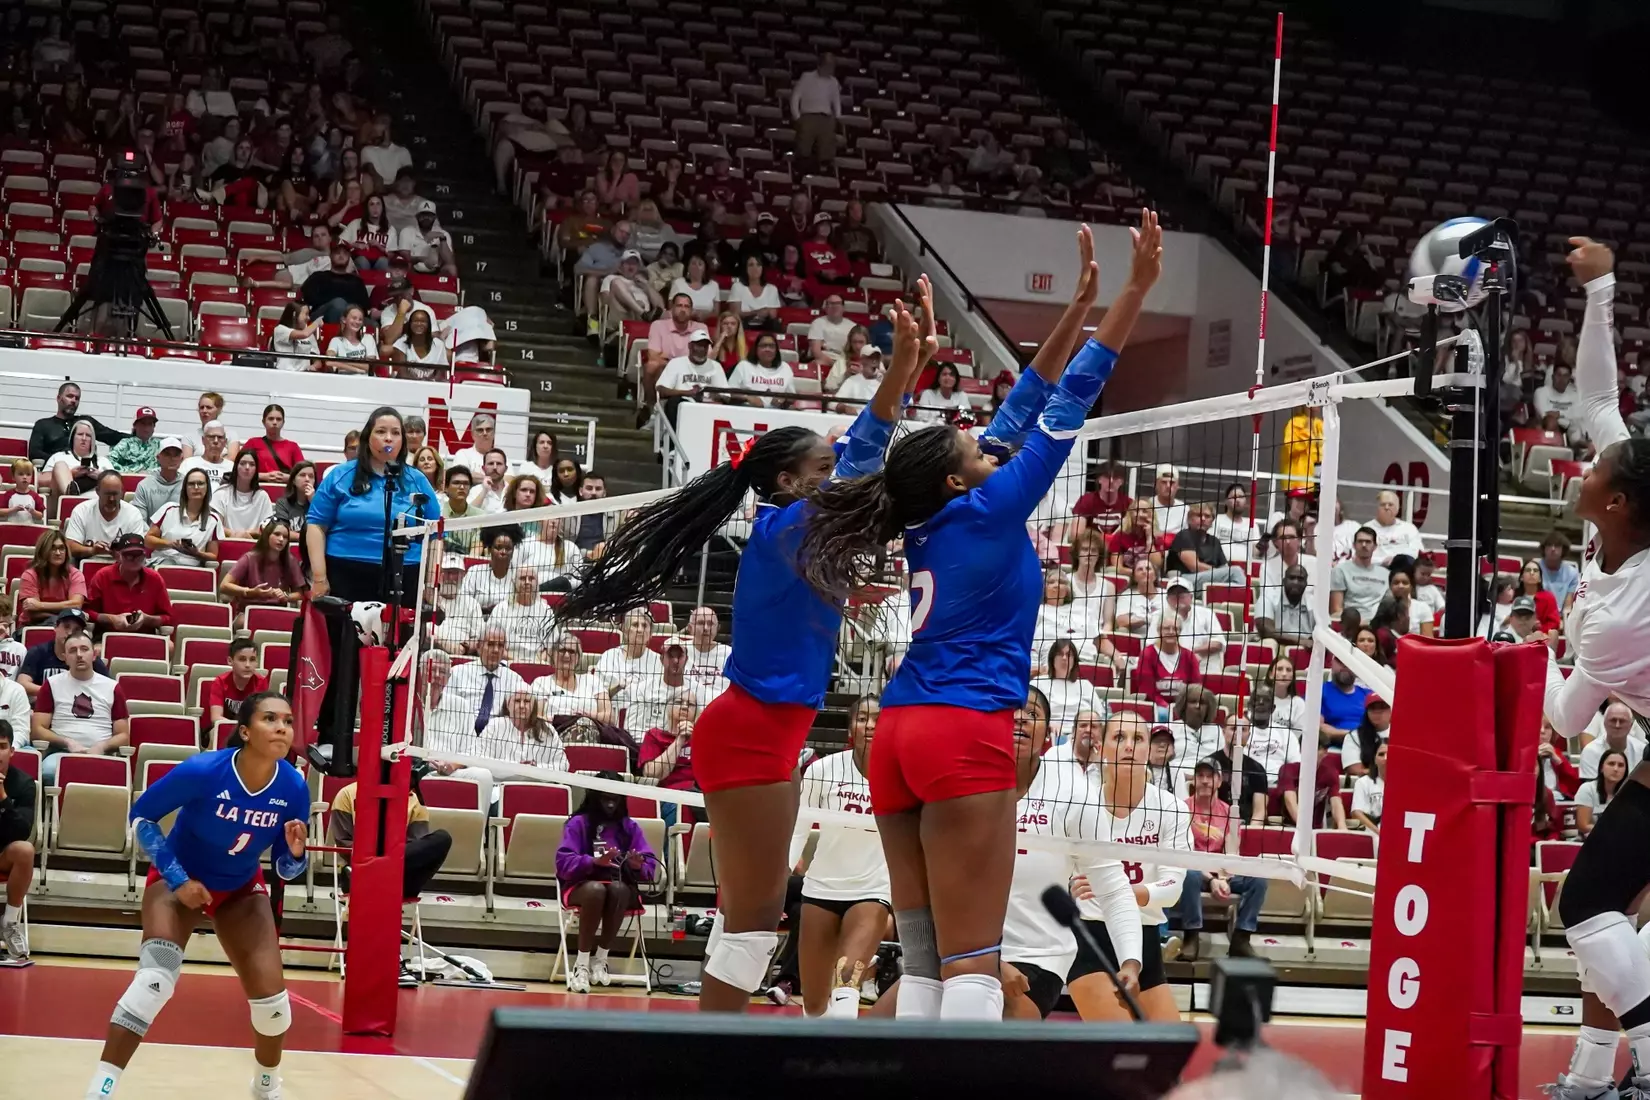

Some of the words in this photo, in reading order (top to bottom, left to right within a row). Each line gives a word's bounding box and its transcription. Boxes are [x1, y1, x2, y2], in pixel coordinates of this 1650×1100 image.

[452, 209, 464, 219] 19
[463, 235, 475, 244] 18
[476, 262, 488, 271] 17
[1032, 273, 1053, 290] EXIT
[490, 291, 502, 301] 16
[505, 321, 518, 331] 15
[521, 350, 534, 360] 14
[540, 381, 552, 391] 13
[428, 397, 498, 455] M
[575, 444, 585, 456] 11
[0, 651, 21, 667] NSAS
[215, 803, 239, 822] LA
[243, 809, 279, 828] TECH
[228, 832, 252, 856] 1
